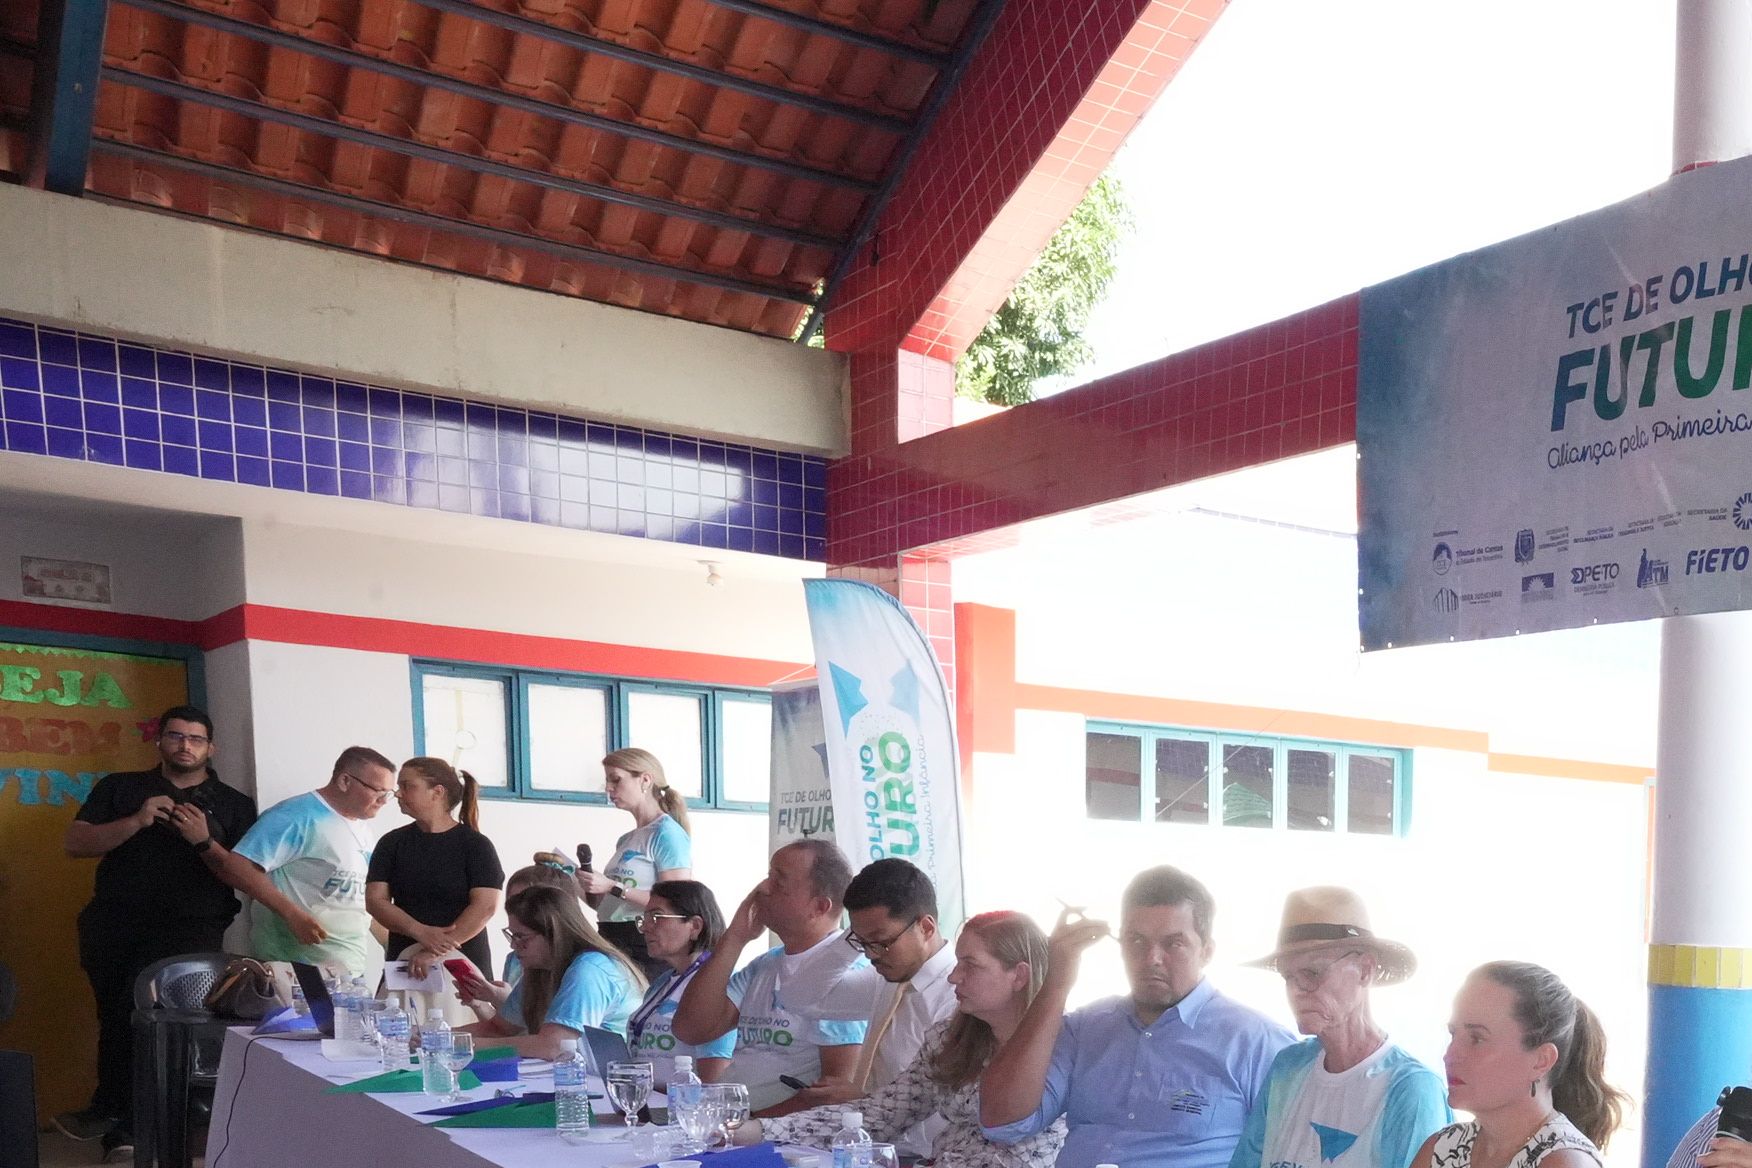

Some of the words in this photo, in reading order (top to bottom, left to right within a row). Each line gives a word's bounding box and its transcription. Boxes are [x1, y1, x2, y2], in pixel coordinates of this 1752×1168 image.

[1566, 291, 1618, 338] TCE
[1623, 275, 1663, 321] DE
[1547, 441, 1616, 469] Aliança
[1619, 425, 1649, 460] pela
[1652, 409, 1752, 443] Primeira
[0, 664, 134, 709] EJA
[860, 745, 876, 782] NO
[795, 790, 806, 802] DE
[808, 788, 831, 801] OLHO
[878, 731, 920, 857] URO
[777, 806, 834, 835] FUTUR
